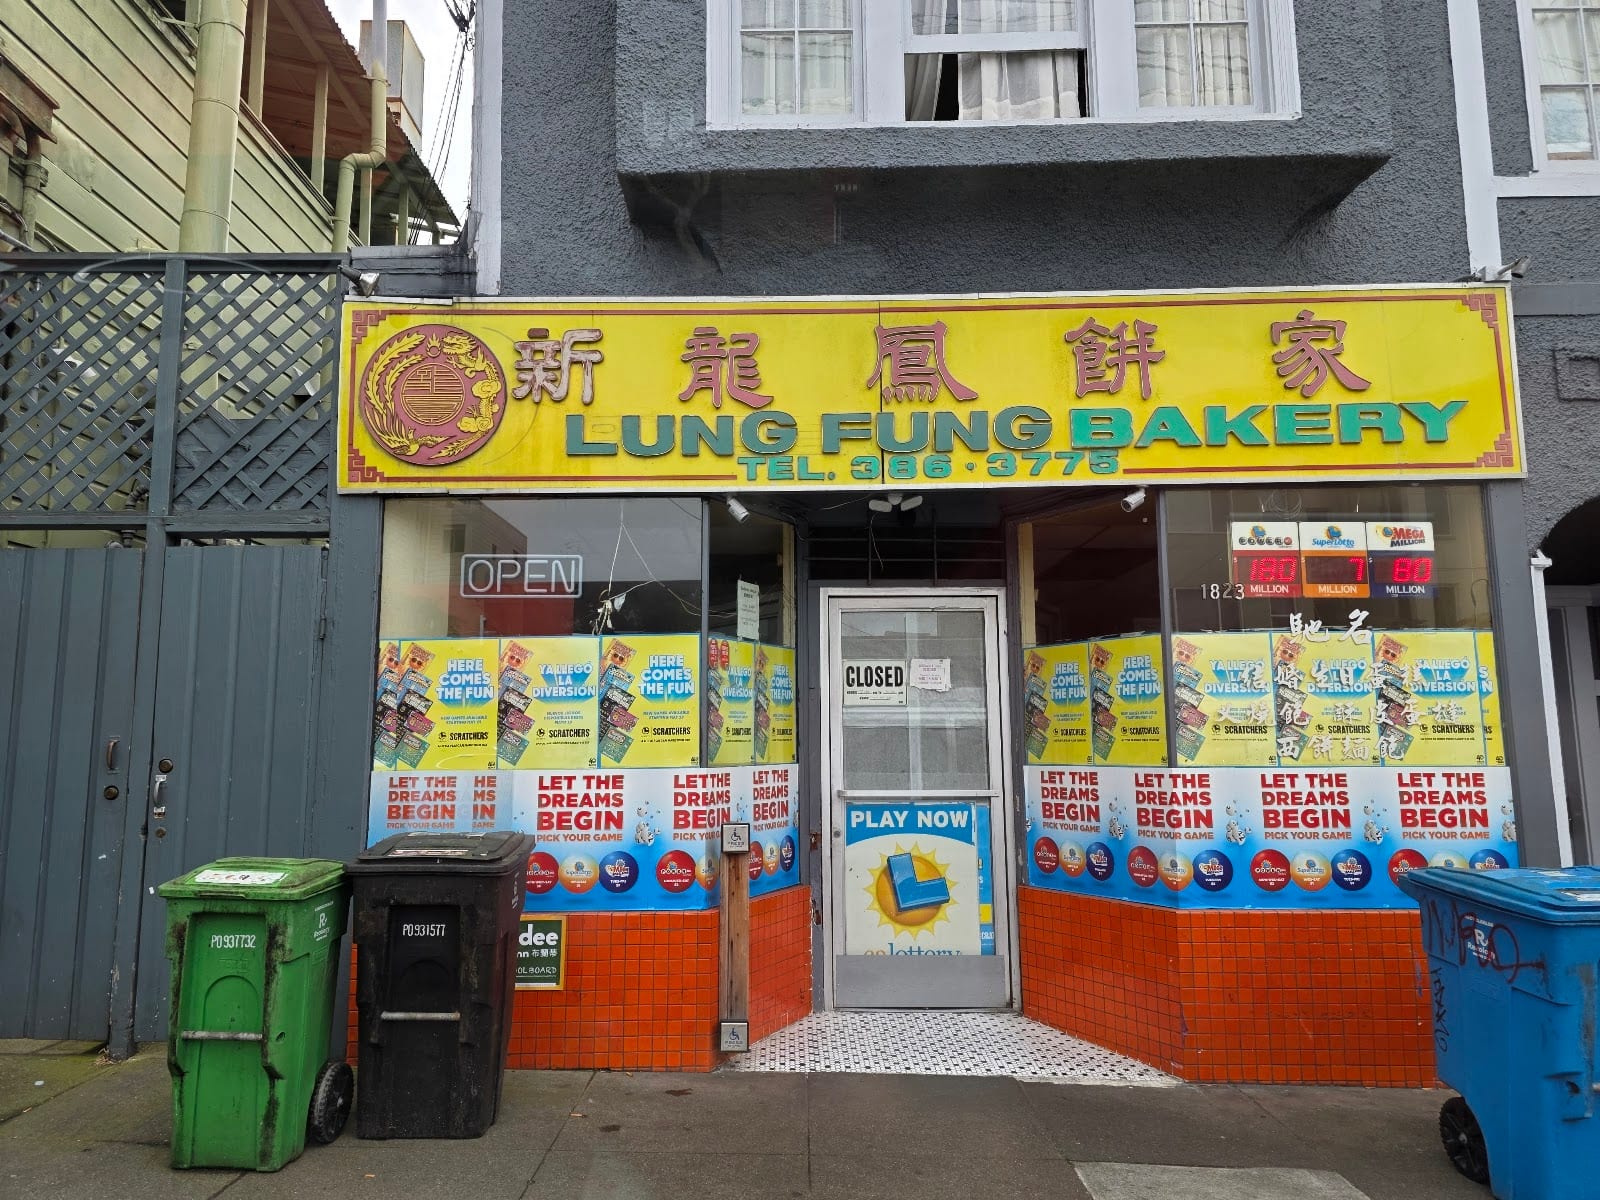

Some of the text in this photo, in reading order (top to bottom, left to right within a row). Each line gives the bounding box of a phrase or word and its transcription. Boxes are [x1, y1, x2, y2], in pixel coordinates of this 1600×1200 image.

[565, 400, 1469, 457] LUNG FUNG BAKERY
[737, 456, 836, 481] TEL.
[1391, 527, 1425, 540] MEGA
[468, 559, 576, 593] OPEN
[1249, 557, 1297, 582] 180
[1349, 557, 1365, 582] 7
[1392, 557, 1433, 582] 80
[1200, 583, 1245, 600] 1823
[1250, 585, 1289, 593] MILLION
[1319, 585, 1357, 593] MILLION
[1386, 585, 1425, 593] MILLION
[447, 659, 484, 672] HERE
[648, 655, 684, 667] HERE
[1055, 662, 1079, 673] HERE
[1123, 656, 1151, 668] HERE
[538, 664, 553, 674] YA
[640, 668, 691, 681] COMES
[1117, 669, 1158, 682] COMES
[1436, 671, 1449, 680] LA
[438, 673, 491, 686] COMES
[558, 676, 573, 686] LA
[845, 665, 904, 688] CLOSED
[1050, 675, 1084, 686] COMES
[436, 687, 495, 700] THE FUN
[638, 682, 695, 695] THE FUN
[1050, 687, 1087, 699] THE FUN
[1115, 682, 1161, 695] THE FUN
[548, 729, 590, 738] SCRATCHERS
[652, 727, 691, 735] SCRATCHERS
[1224, 725, 1267, 734] SCRATCHERS
[1328, 725, 1370, 733] SCRATCHERS
[1432, 725, 1474, 733] SCRATCHERS
[450, 732, 488, 740] SCRATCHERS
[388, 776, 457, 788] LET THE
[538, 775, 624, 790] LET THE
[673, 772, 731, 789] LET THE
[753, 769, 789, 784] LET THE
[1040, 771, 1098, 785] LET THE
[1135, 773, 1210, 788] LET THE
[1261, 773, 1348, 788] LET THE
[1397, 772, 1485, 788] LET THE
[388, 790, 456, 802] DREAMS
[673, 789, 731, 807] DREAMS
[752, 785, 789, 800] DREAMS
[1041, 787, 1099, 802] DREAMS
[1136, 791, 1211, 806] DREAMS
[1261, 791, 1349, 806] DREAMS
[1399, 790, 1487, 805] DREAMS
[537, 793, 624, 808] DREAMS
[387, 804, 456, 820] BEGIN
[752, 800, 789, 822] BEGIN
[1042, 802, 1100, 822] BEGIN
[536, 811, 623, 831] BEGIN
[673, 807, 731, 830] BEGIN
[851, 810, 968, 828] PLAY NOW
[1136, 808, 1213, 828] BEGIN
[1262, 809, 1351, 829] BEGIN
[1400, 808, 1489, 828] BEGIN
[1043, 822, 1100, 832] PICK YOUR GAME
[536, 833, 622, 842] PICK YOUR GAME
[673, 832, 695, 840] PICK
[699, 832, 716, 840] YOUR
[1138, 829, 1214, 840] PICK YOUR GAME
[1264, 831, 1352, 840] PICK YOUR GAME
[1402, 831, 1490, 840] PICK YOUR GAME
